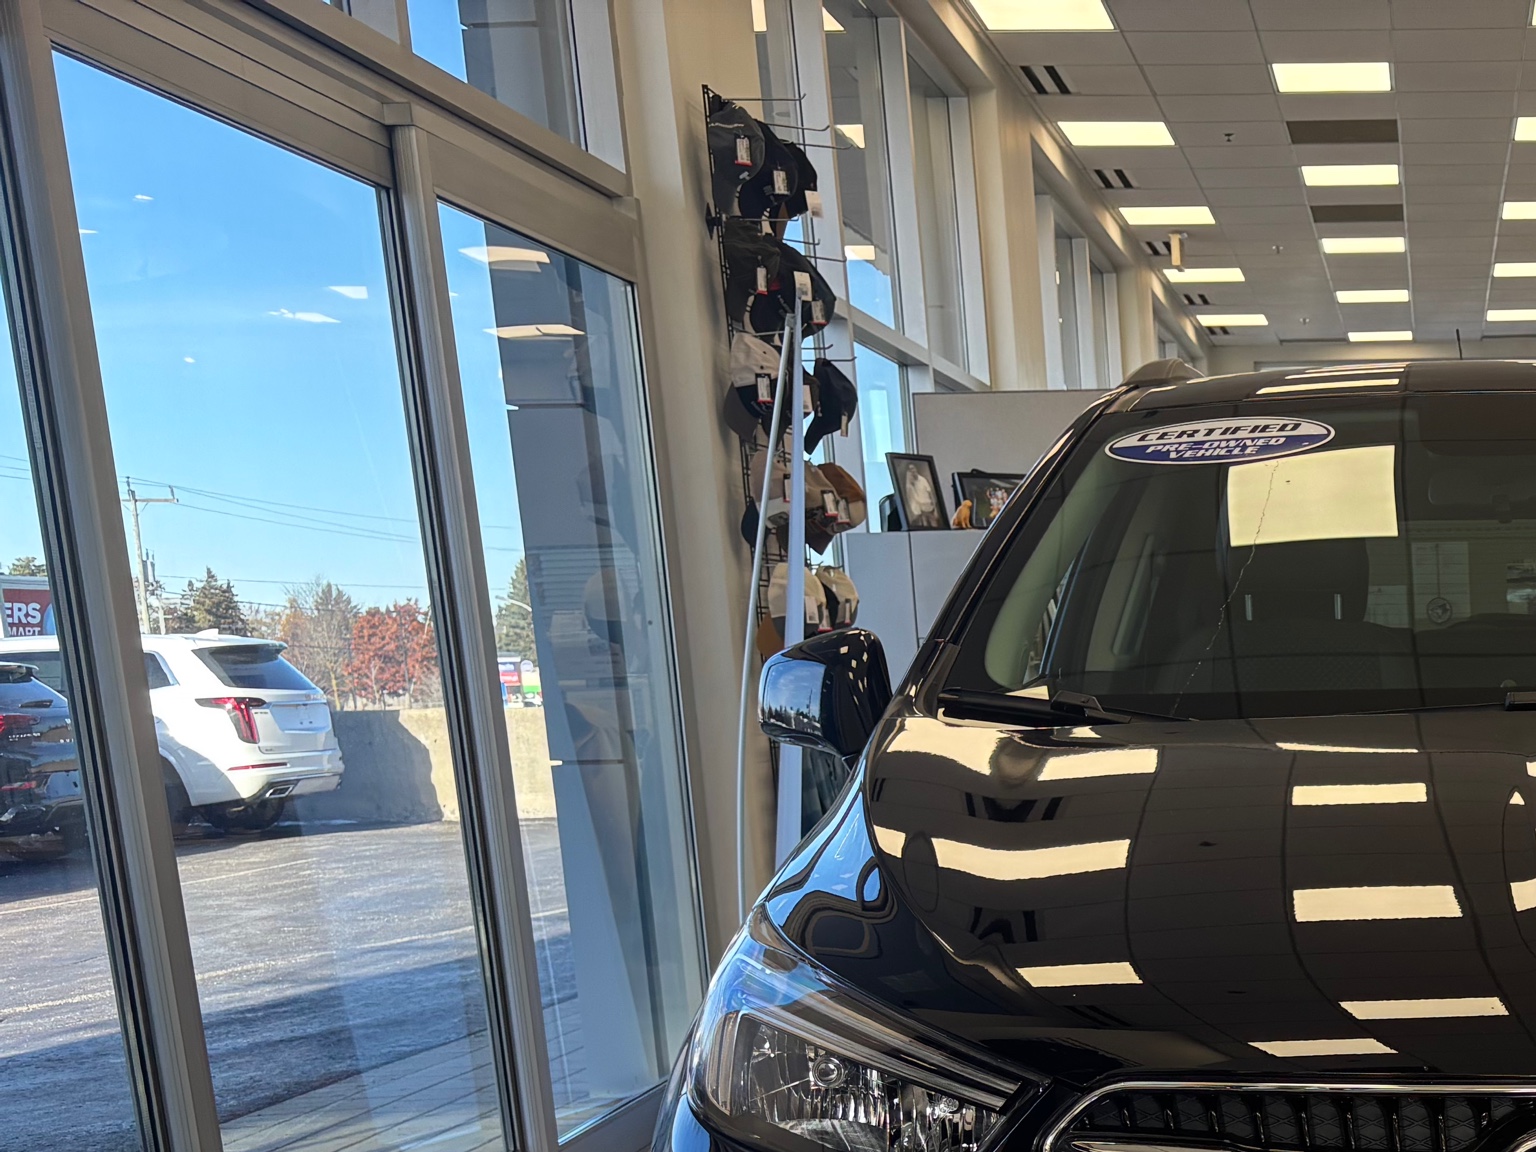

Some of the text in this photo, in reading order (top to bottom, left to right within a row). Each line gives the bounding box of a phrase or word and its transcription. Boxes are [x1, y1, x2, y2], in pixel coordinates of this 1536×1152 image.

[1137, 422, 1302, 442] CERTIFIED
[1145, 437, 1287, 454] PRE-OWNED
[1168, 445, 1260, 459] VEHICLE
